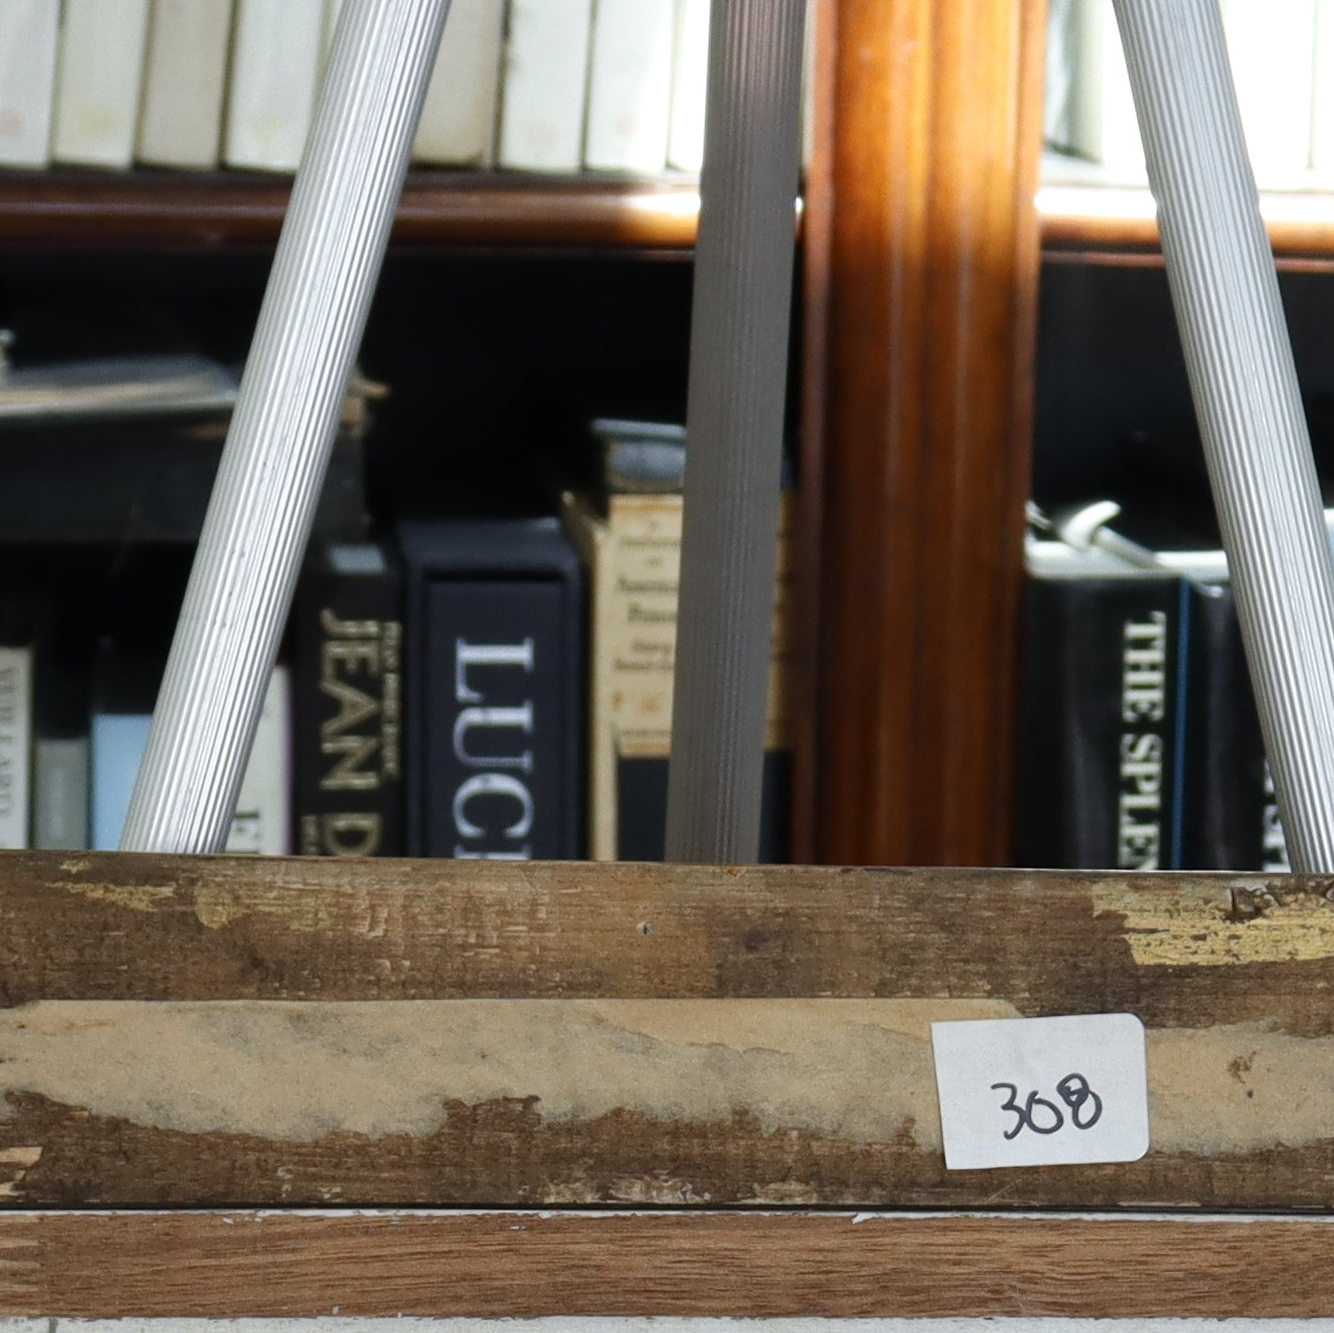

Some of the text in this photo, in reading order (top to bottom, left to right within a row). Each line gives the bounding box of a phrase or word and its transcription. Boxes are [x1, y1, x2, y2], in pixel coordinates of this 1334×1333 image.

[319, 607, 381, 791] JEAN
[1122, 609, 1167, 724] THE
[989, 1072, 1103, 1141] 308
